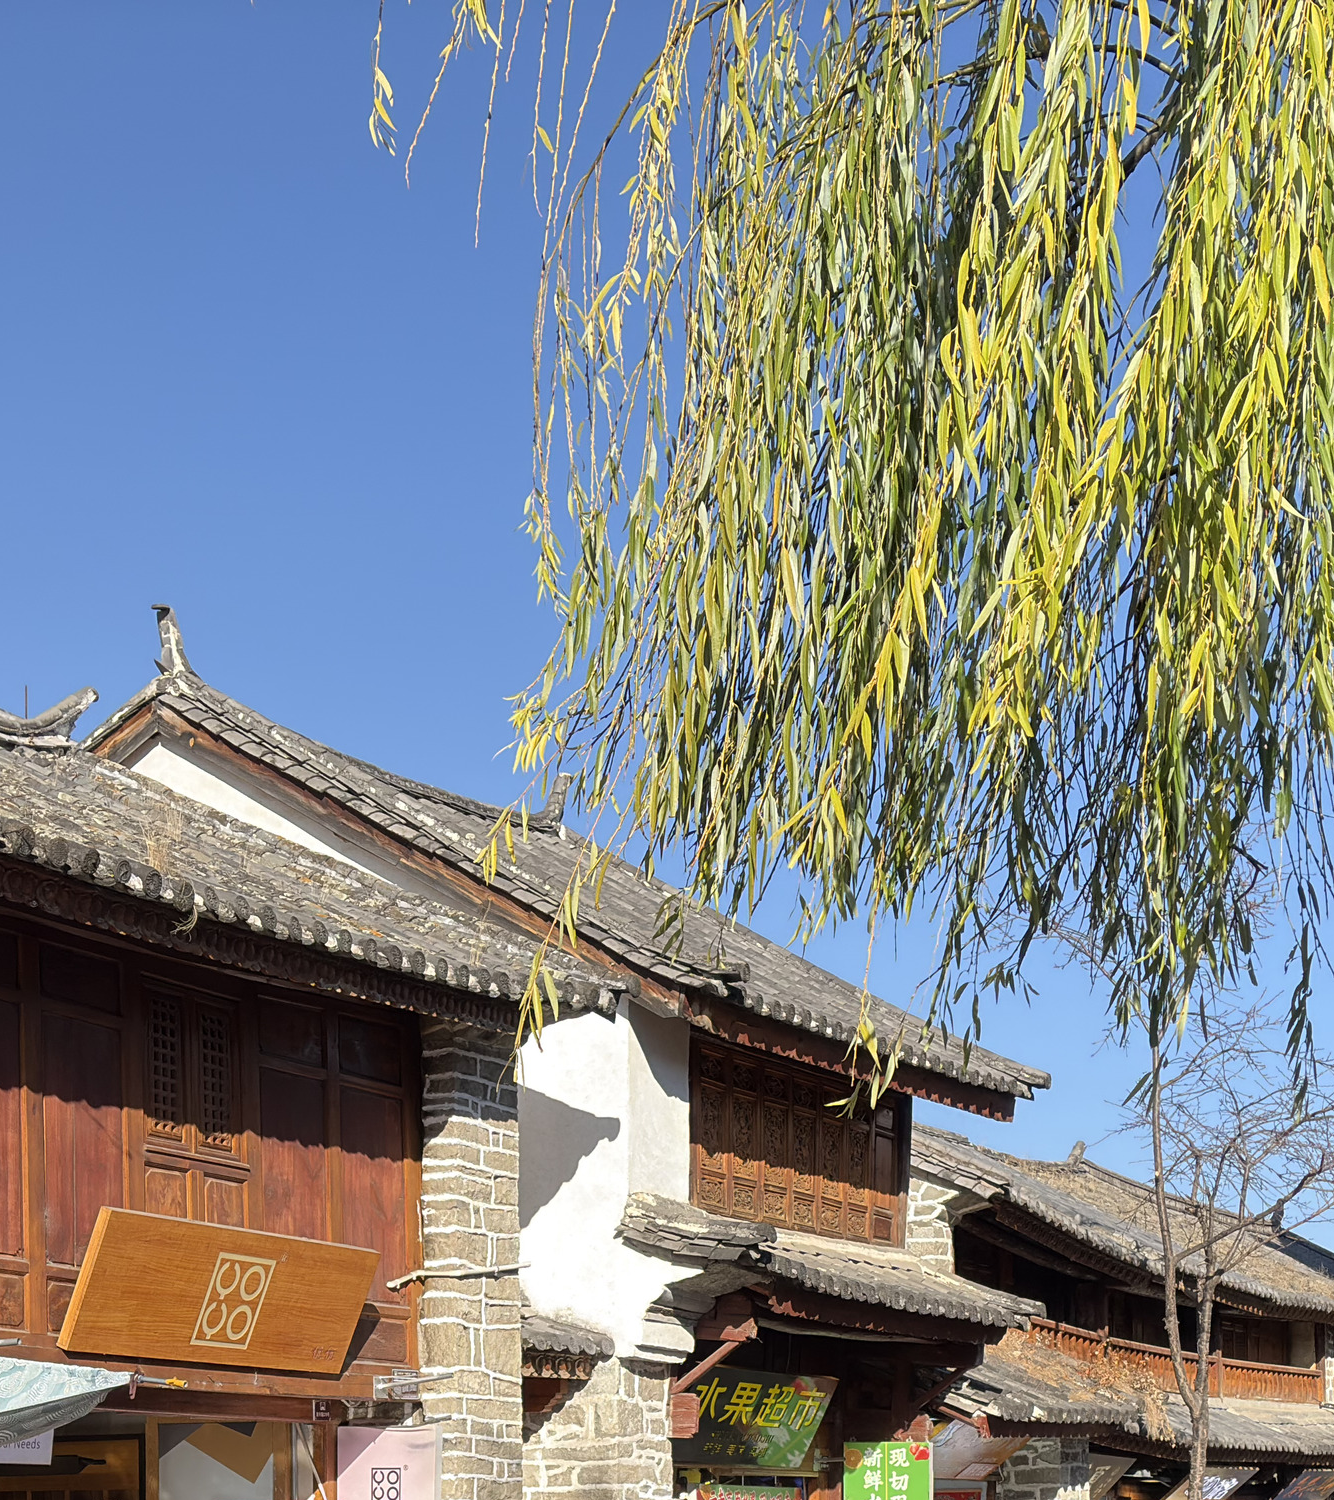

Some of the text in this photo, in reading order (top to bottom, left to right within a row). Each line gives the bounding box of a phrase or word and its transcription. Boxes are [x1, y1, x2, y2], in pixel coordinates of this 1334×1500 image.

[696, 1377, 827, 1430] 水果超市
[13, 1438, 41, 1449] Needs
